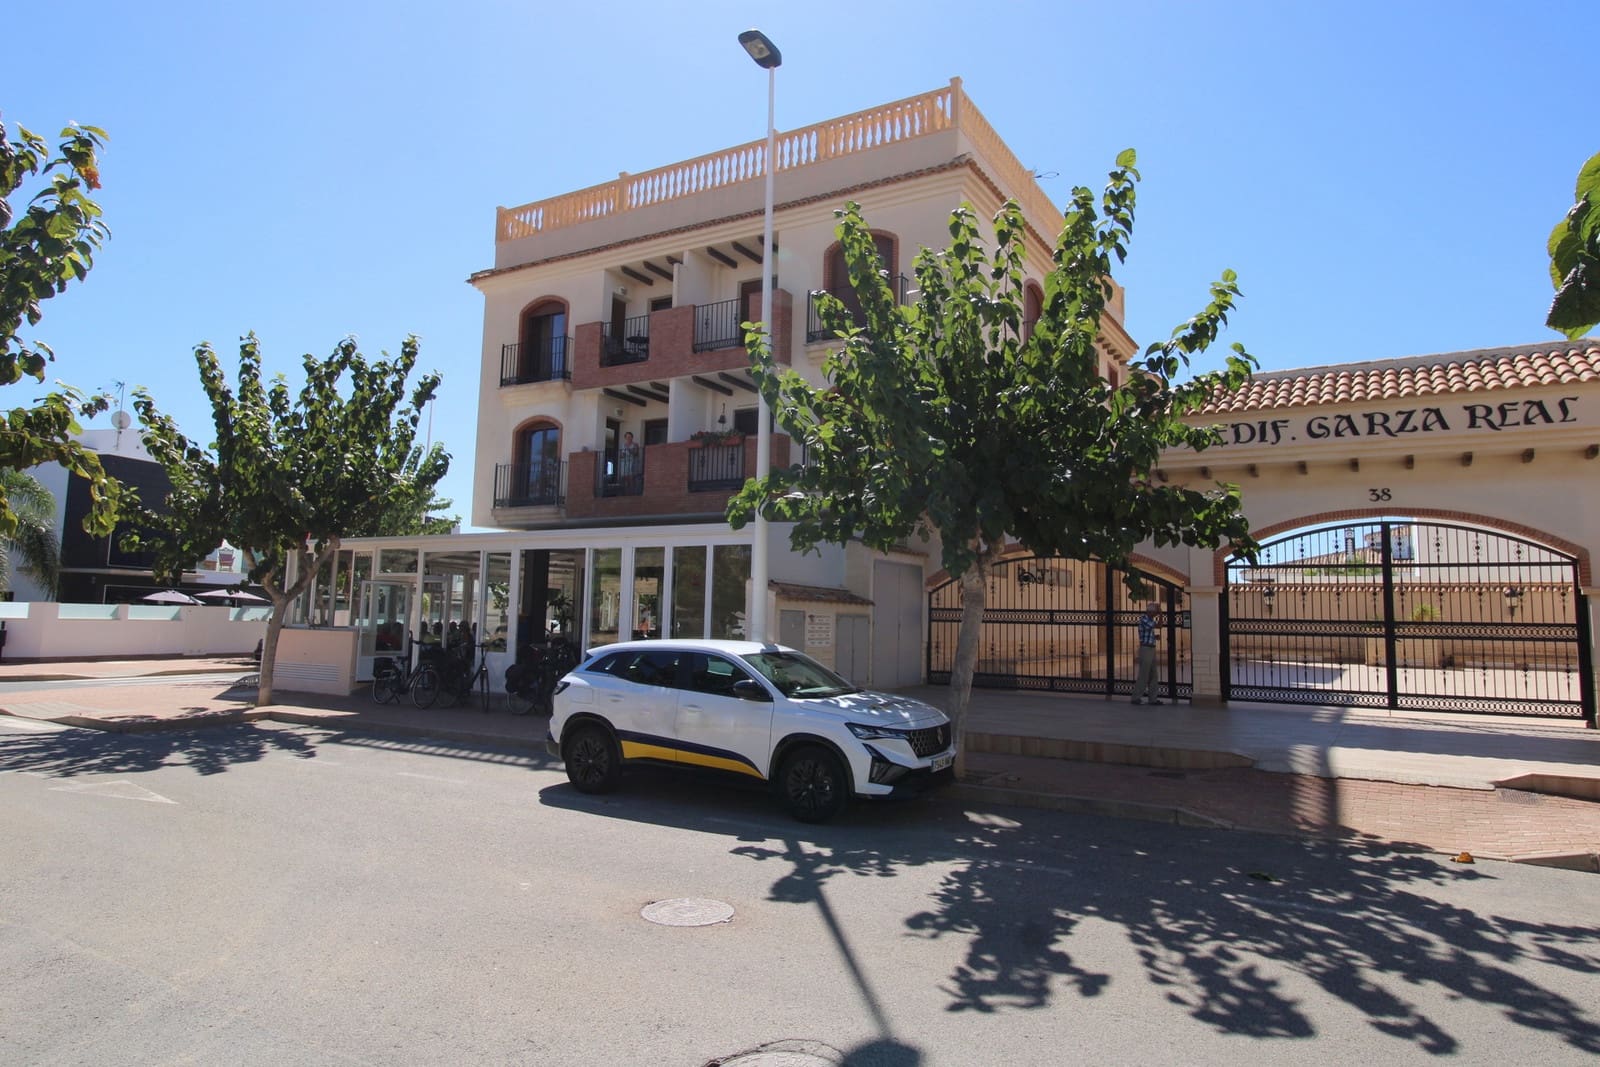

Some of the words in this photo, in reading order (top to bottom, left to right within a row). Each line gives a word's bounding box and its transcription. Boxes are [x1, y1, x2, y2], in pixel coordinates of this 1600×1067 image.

[1306, 407, 1451, 440] GARZA
[1463, 396, 1579, 431] REAL
[1368, 487, 1392, 502] 38
